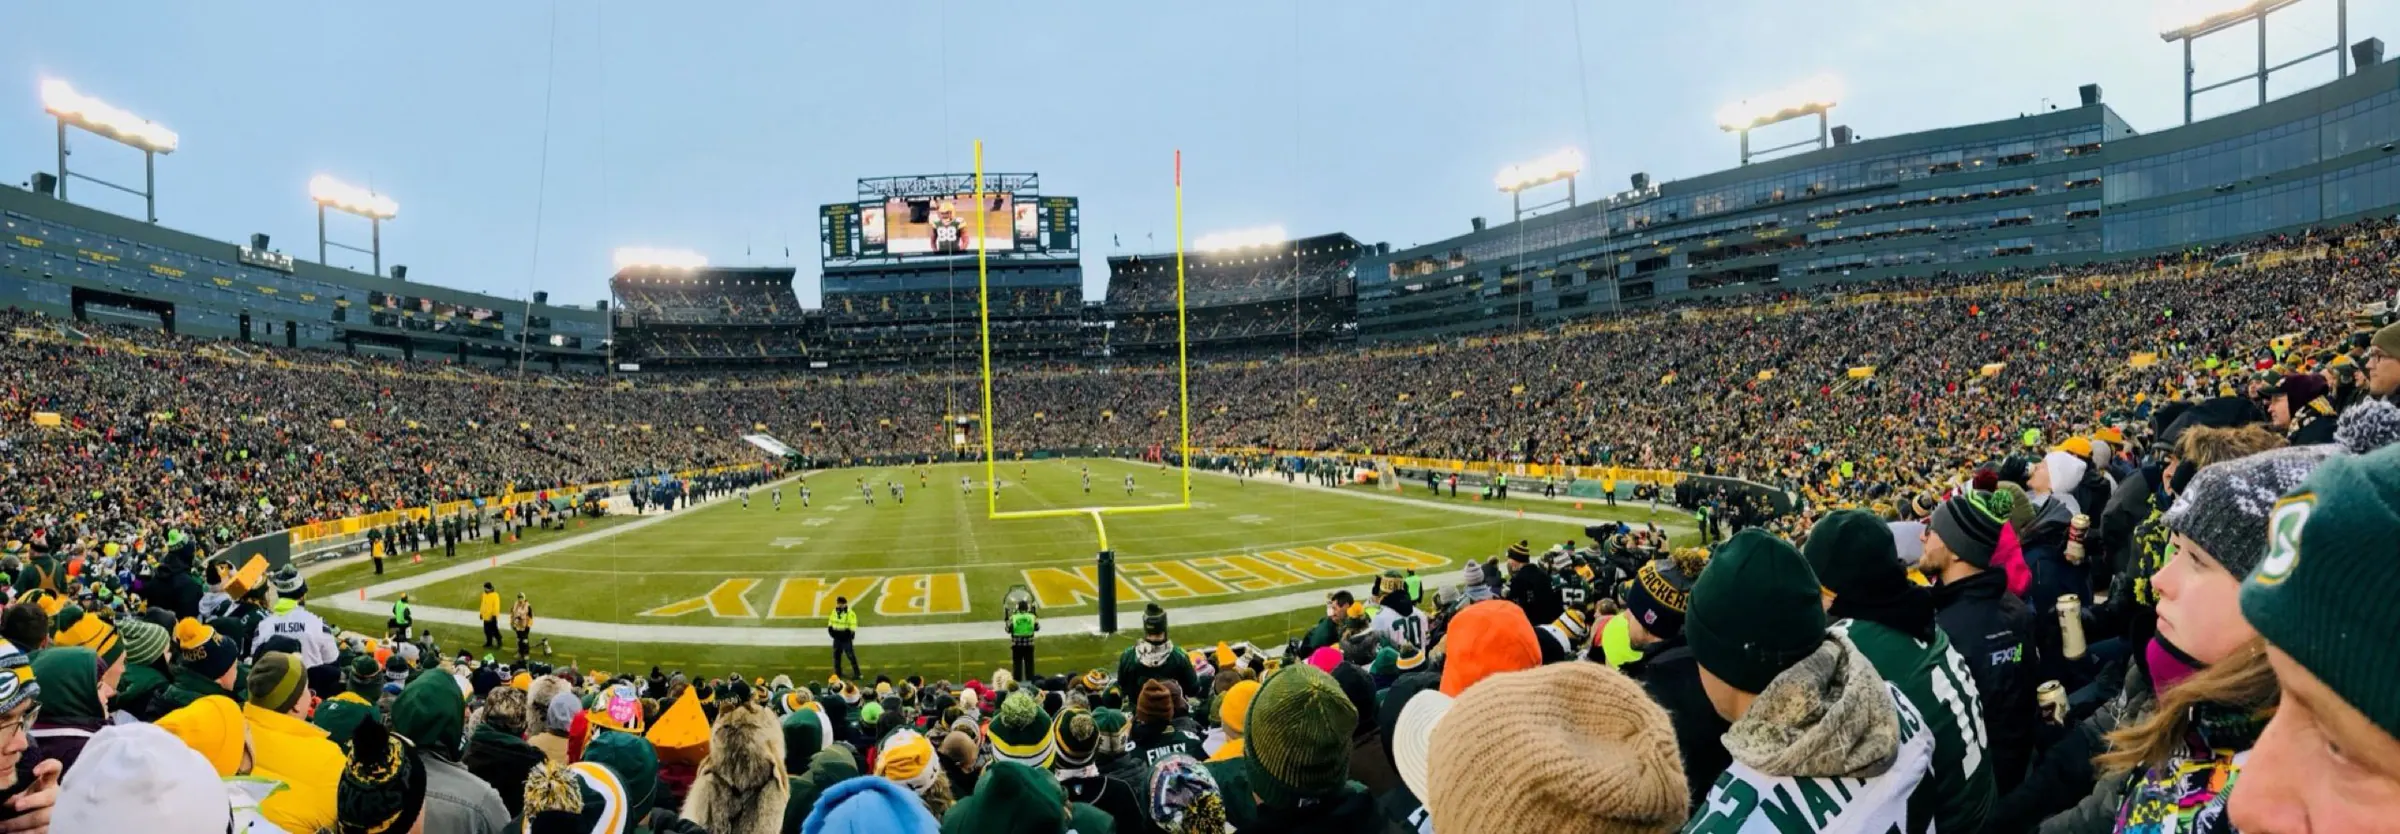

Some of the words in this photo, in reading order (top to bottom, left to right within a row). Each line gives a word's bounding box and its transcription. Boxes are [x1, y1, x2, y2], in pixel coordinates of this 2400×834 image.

[873, 177, 961, 196] LAMBEAU
[937, 226, 957, 242] 88
[1021, 541, 1453, 608] GREEN
[635, 572, 972, 618] BAY
[274, 622, 306, 633] WILSON
